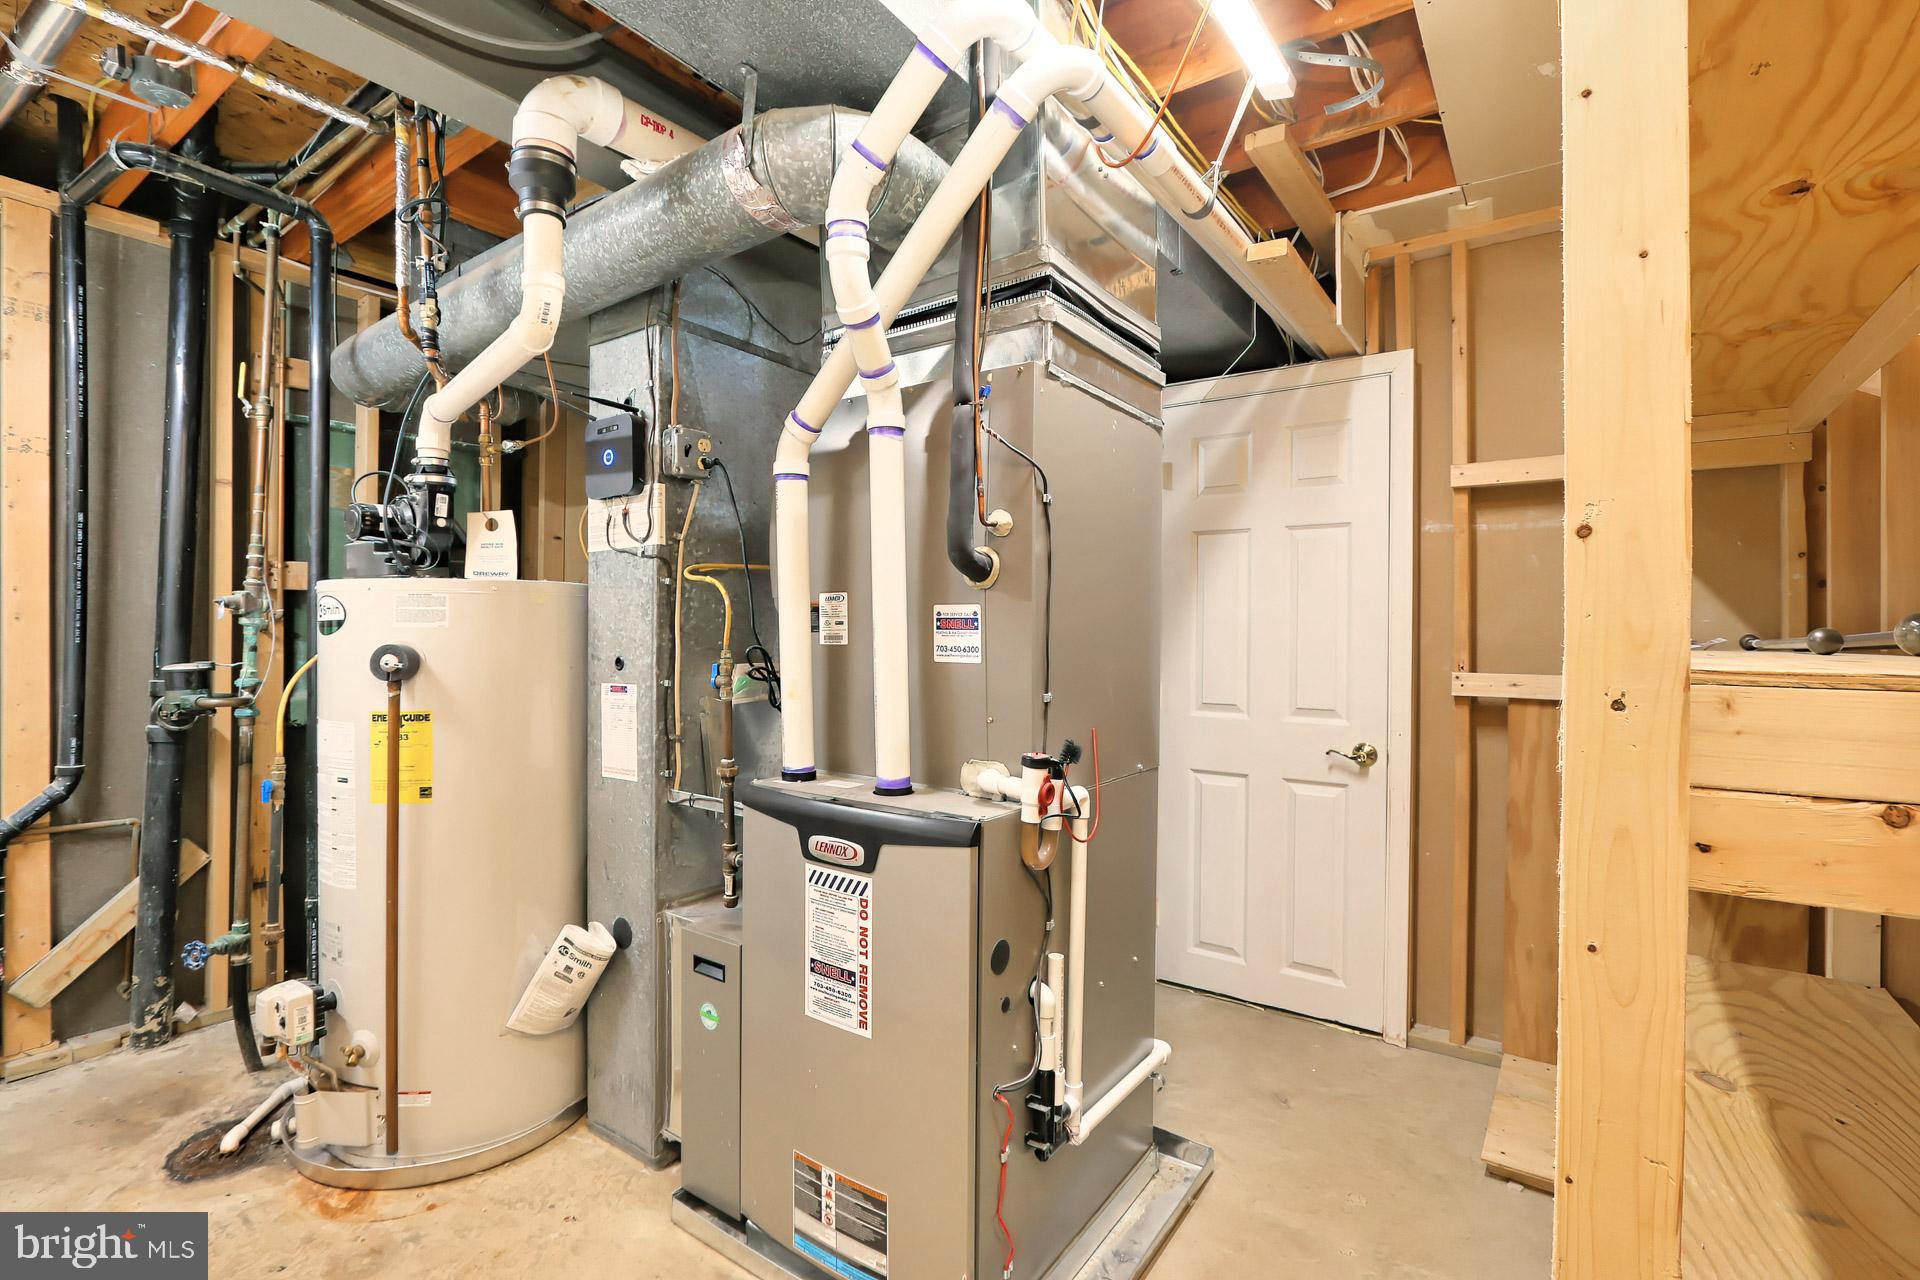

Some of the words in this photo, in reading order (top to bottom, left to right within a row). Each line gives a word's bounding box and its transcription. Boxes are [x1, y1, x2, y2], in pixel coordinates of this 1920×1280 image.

[940, 619, 975, 630] SNELL
[935, 644, 980, 653] 703-450-6300
[814, 840, 849, 858] LENNOX
[859, 898, 869, 921] DO
[859, 926, 869, 960] NOT
[568, 951, 593, 970] Smith
[813, 960, 852, 985] SNELL
[813, 981, 853, 999] 703-450-6300
[859, 963, 869, 1031] REMOVE
